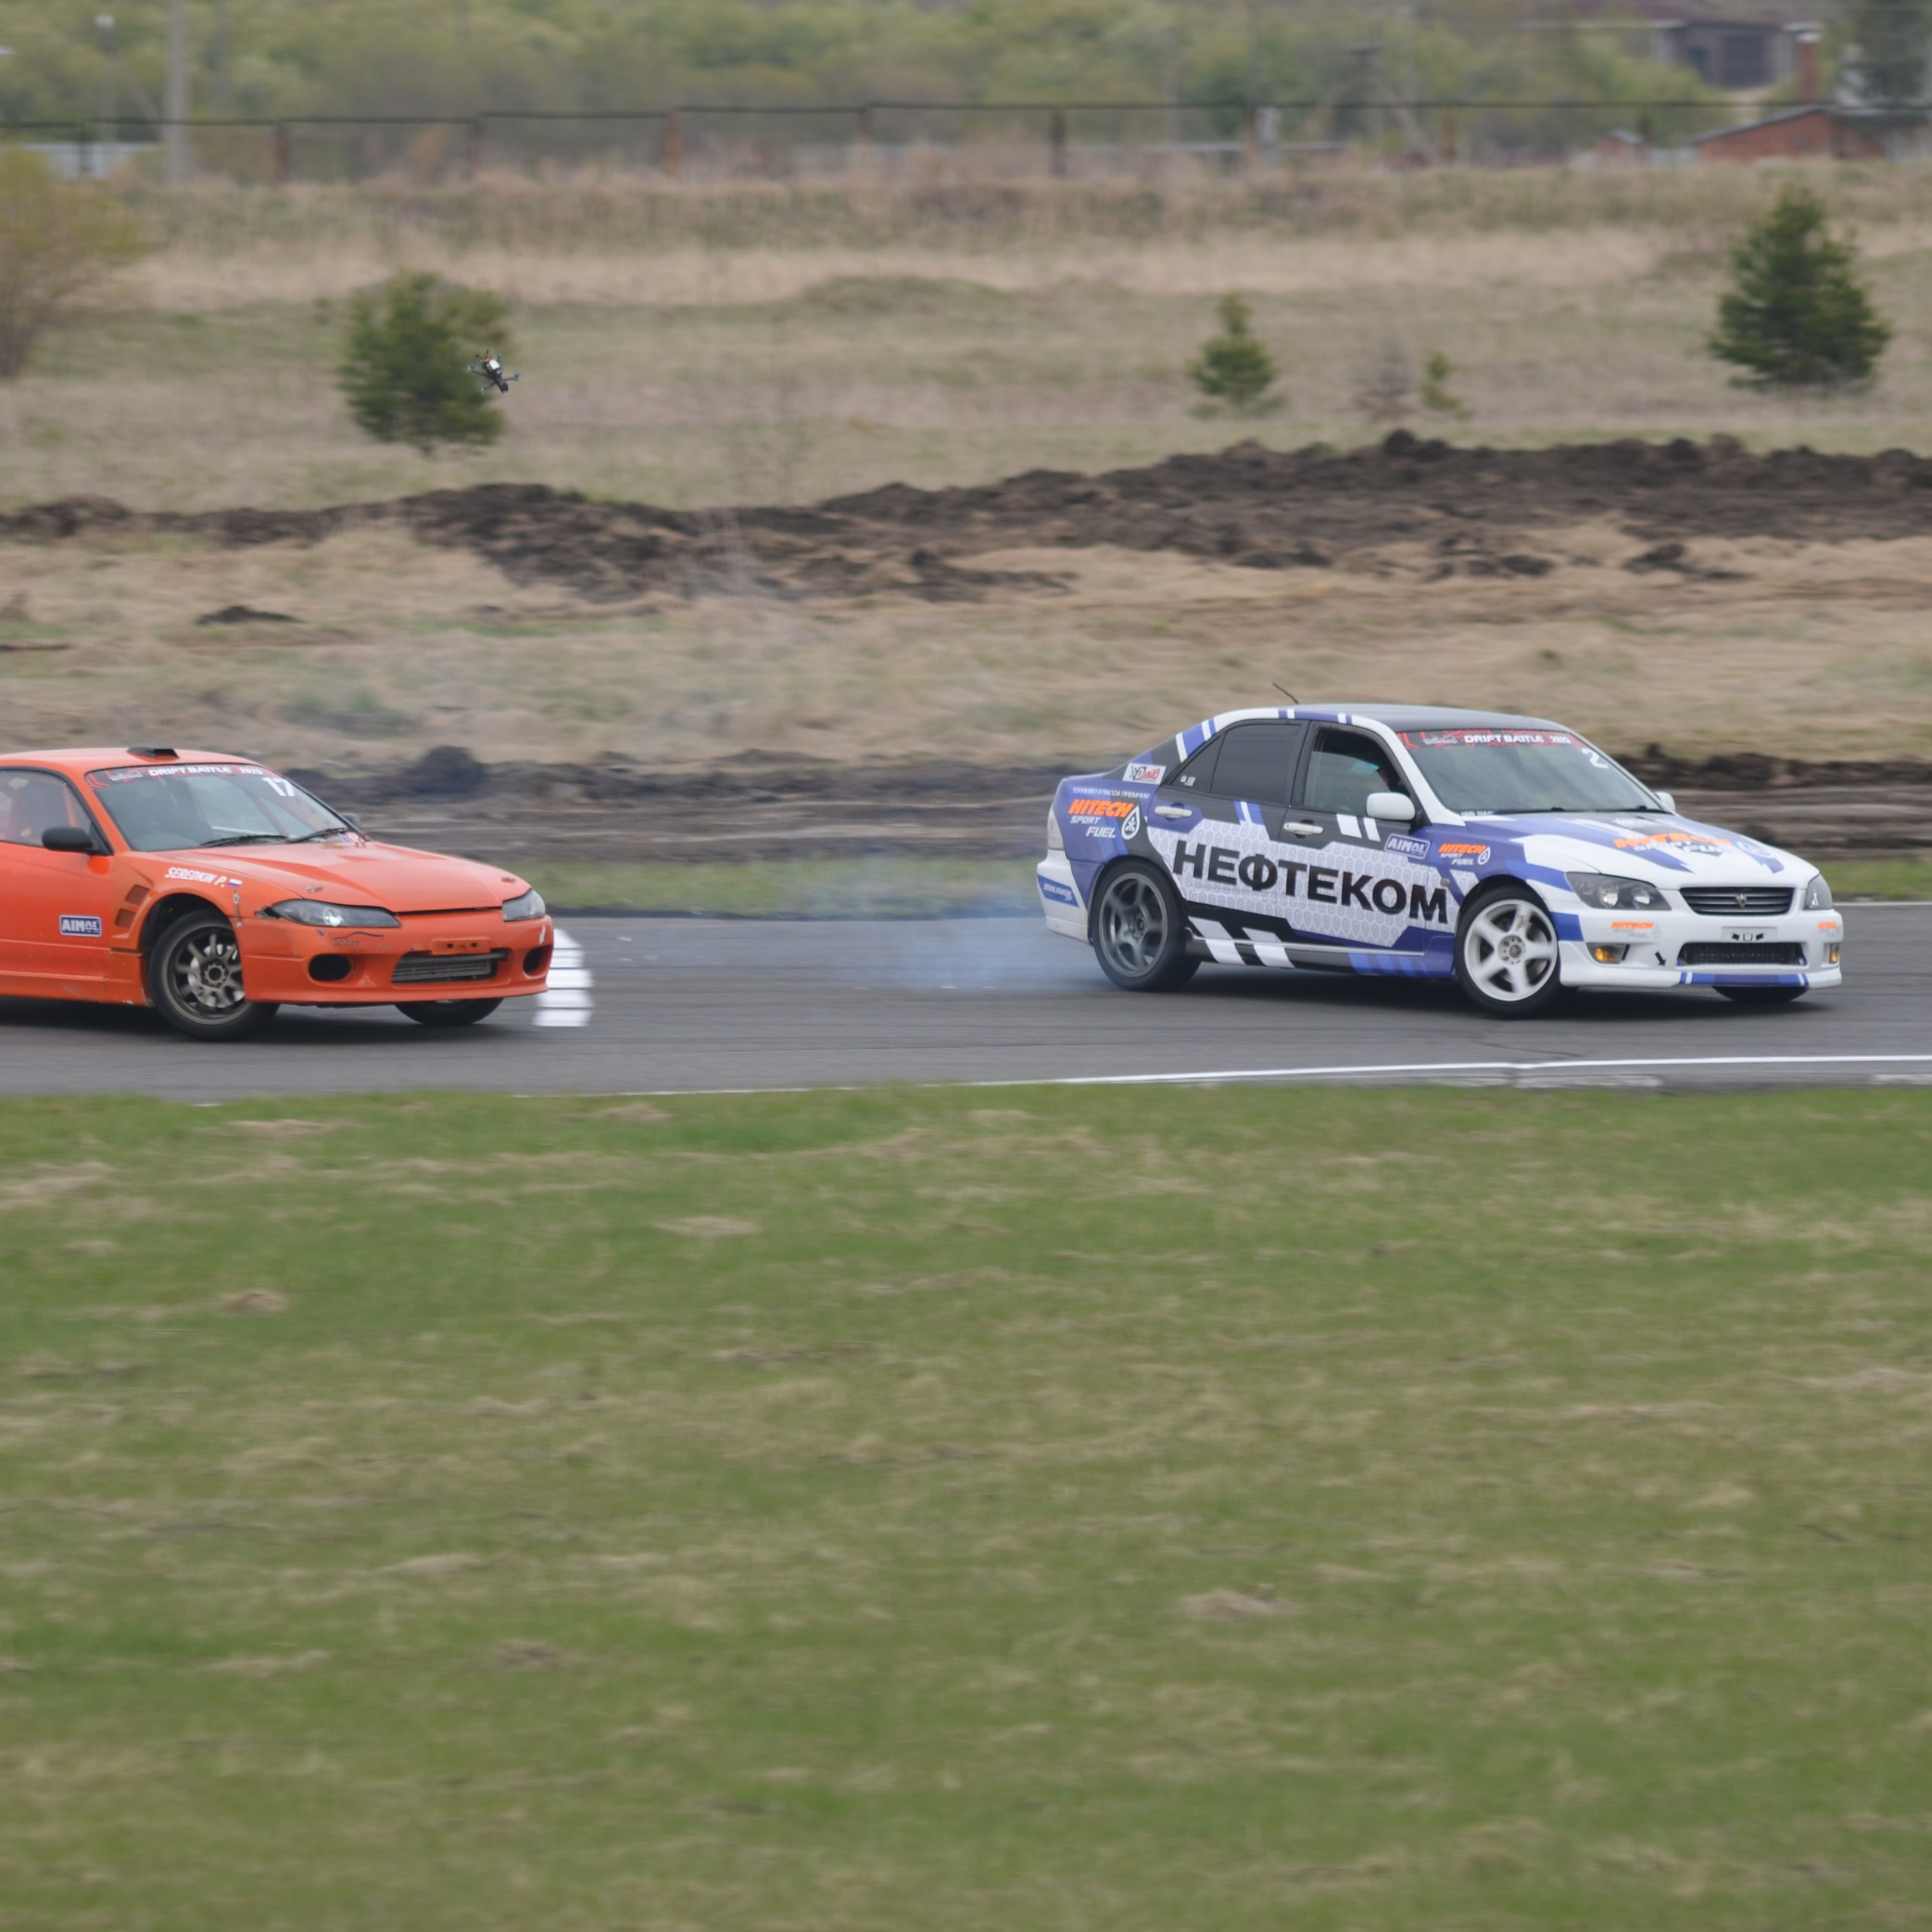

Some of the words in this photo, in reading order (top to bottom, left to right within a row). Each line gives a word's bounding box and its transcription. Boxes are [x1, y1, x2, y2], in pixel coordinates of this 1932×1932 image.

[1464, 734, 1502, 743] DRIFT
[1503, 734, 1544, 743] BATTLE
[1581, 748, 1609, 769] 2
[148, 767, 186, 777] DRIFT
[263, 777, 295, 797] 17
[1068, 798, 1135, 818] HITECH
[1070, 816, 1101, 824] SPORT
[1085, 826, 1116, 838] FUEL
[1387, 837, 1426, 854] AIMOL
[1438, 843, 1487, 854] HITECH
[1172, 839, 1447, 924] НЕФТЕКОМ
